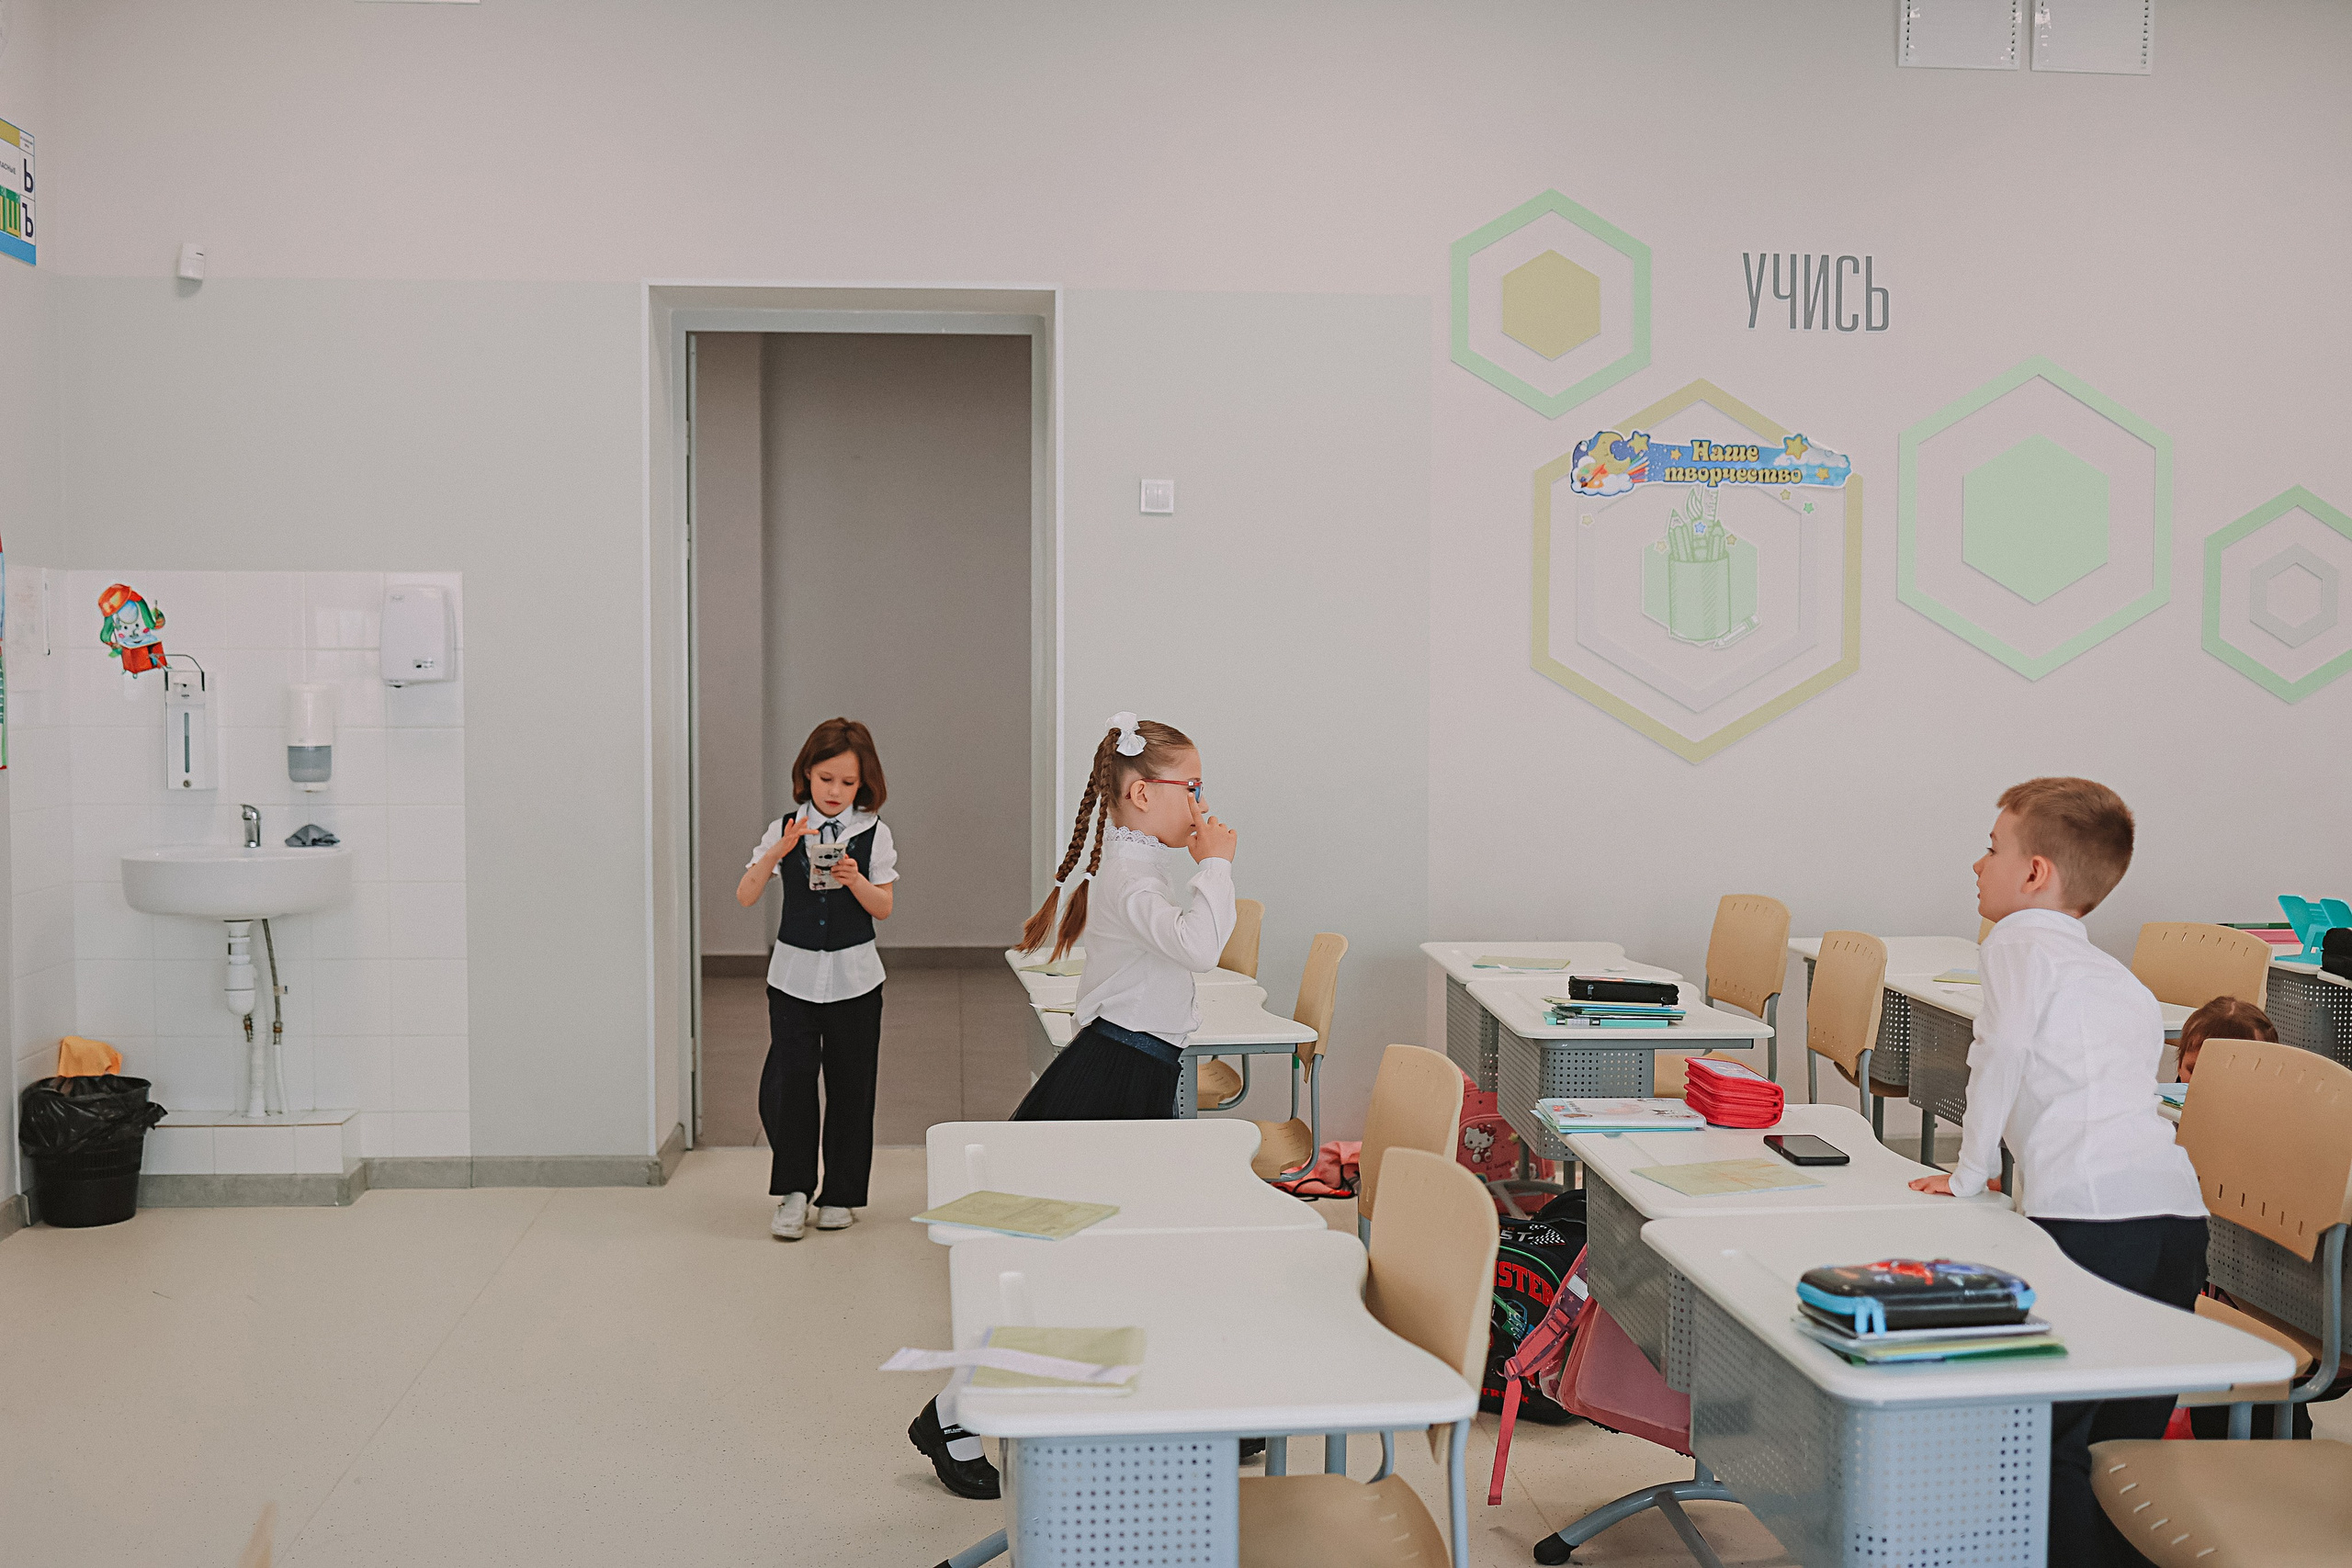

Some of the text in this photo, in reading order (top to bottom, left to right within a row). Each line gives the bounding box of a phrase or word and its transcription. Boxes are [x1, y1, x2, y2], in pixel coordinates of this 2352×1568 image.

[23, 158, 34, 193] Ь
[22, 202, 34, 237] Ъ
[1742, 253, 1890, 332] УЧИСЬ
[1690, 439, 1759, 462] Наше
[1664, 466, 1804, 487] творчество
